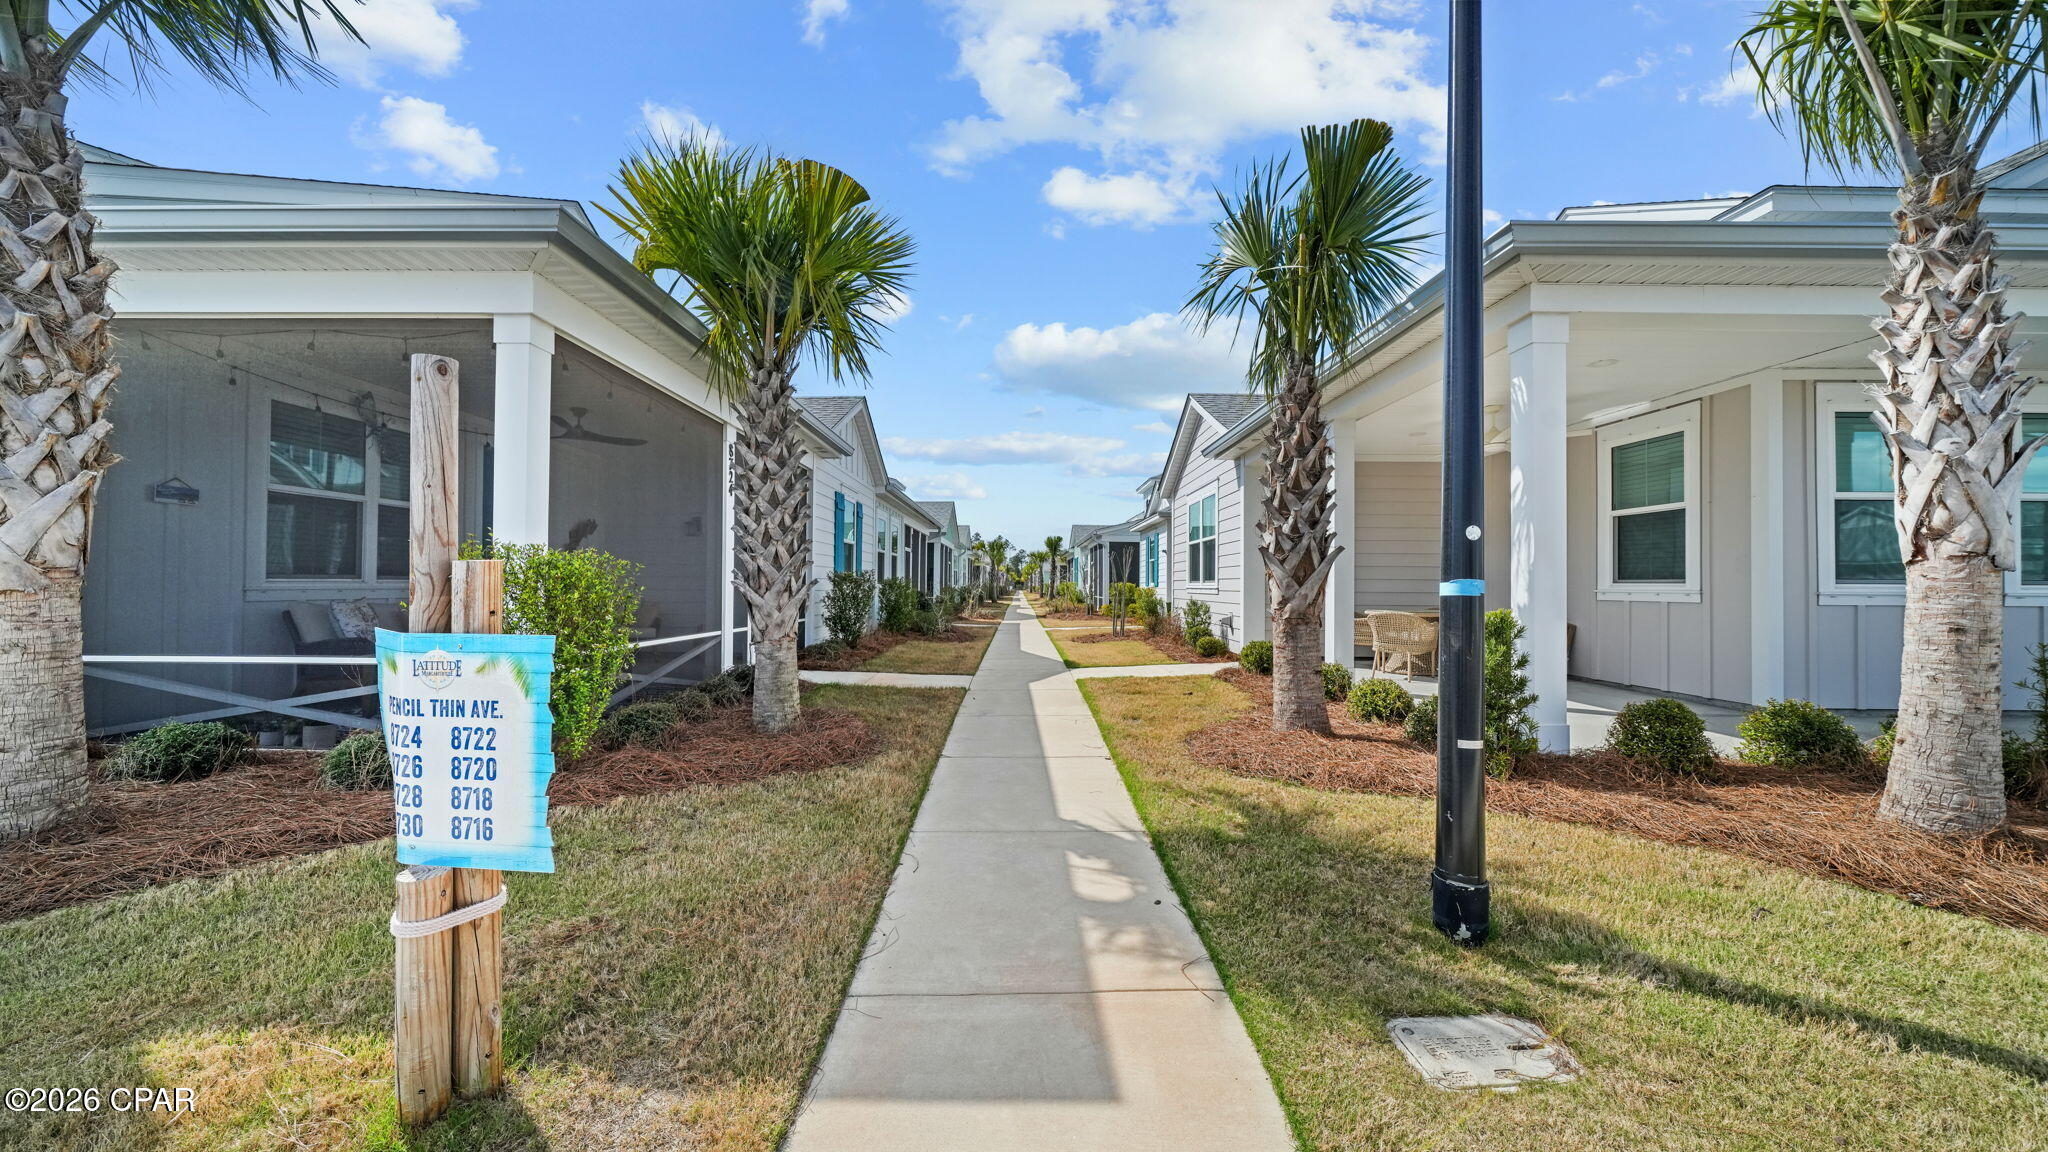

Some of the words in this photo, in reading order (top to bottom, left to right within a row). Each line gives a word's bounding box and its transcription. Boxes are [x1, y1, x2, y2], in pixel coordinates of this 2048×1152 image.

[412, 659, 462, 677] LATITUDE
[389, 696, 424, 717] PENCIL
[430, 699, 465, 718] THIN
[471, 700, 504, 719] AVE.
[451, 727, 497, 751] 8722
[451, 757, 497, 781] 8720
[395, 783, 423, 808] 728
[451, 787, 493, 811] 8718
[397, 812, 423, 838] 730
[451, 816, 493, 841] 8716
